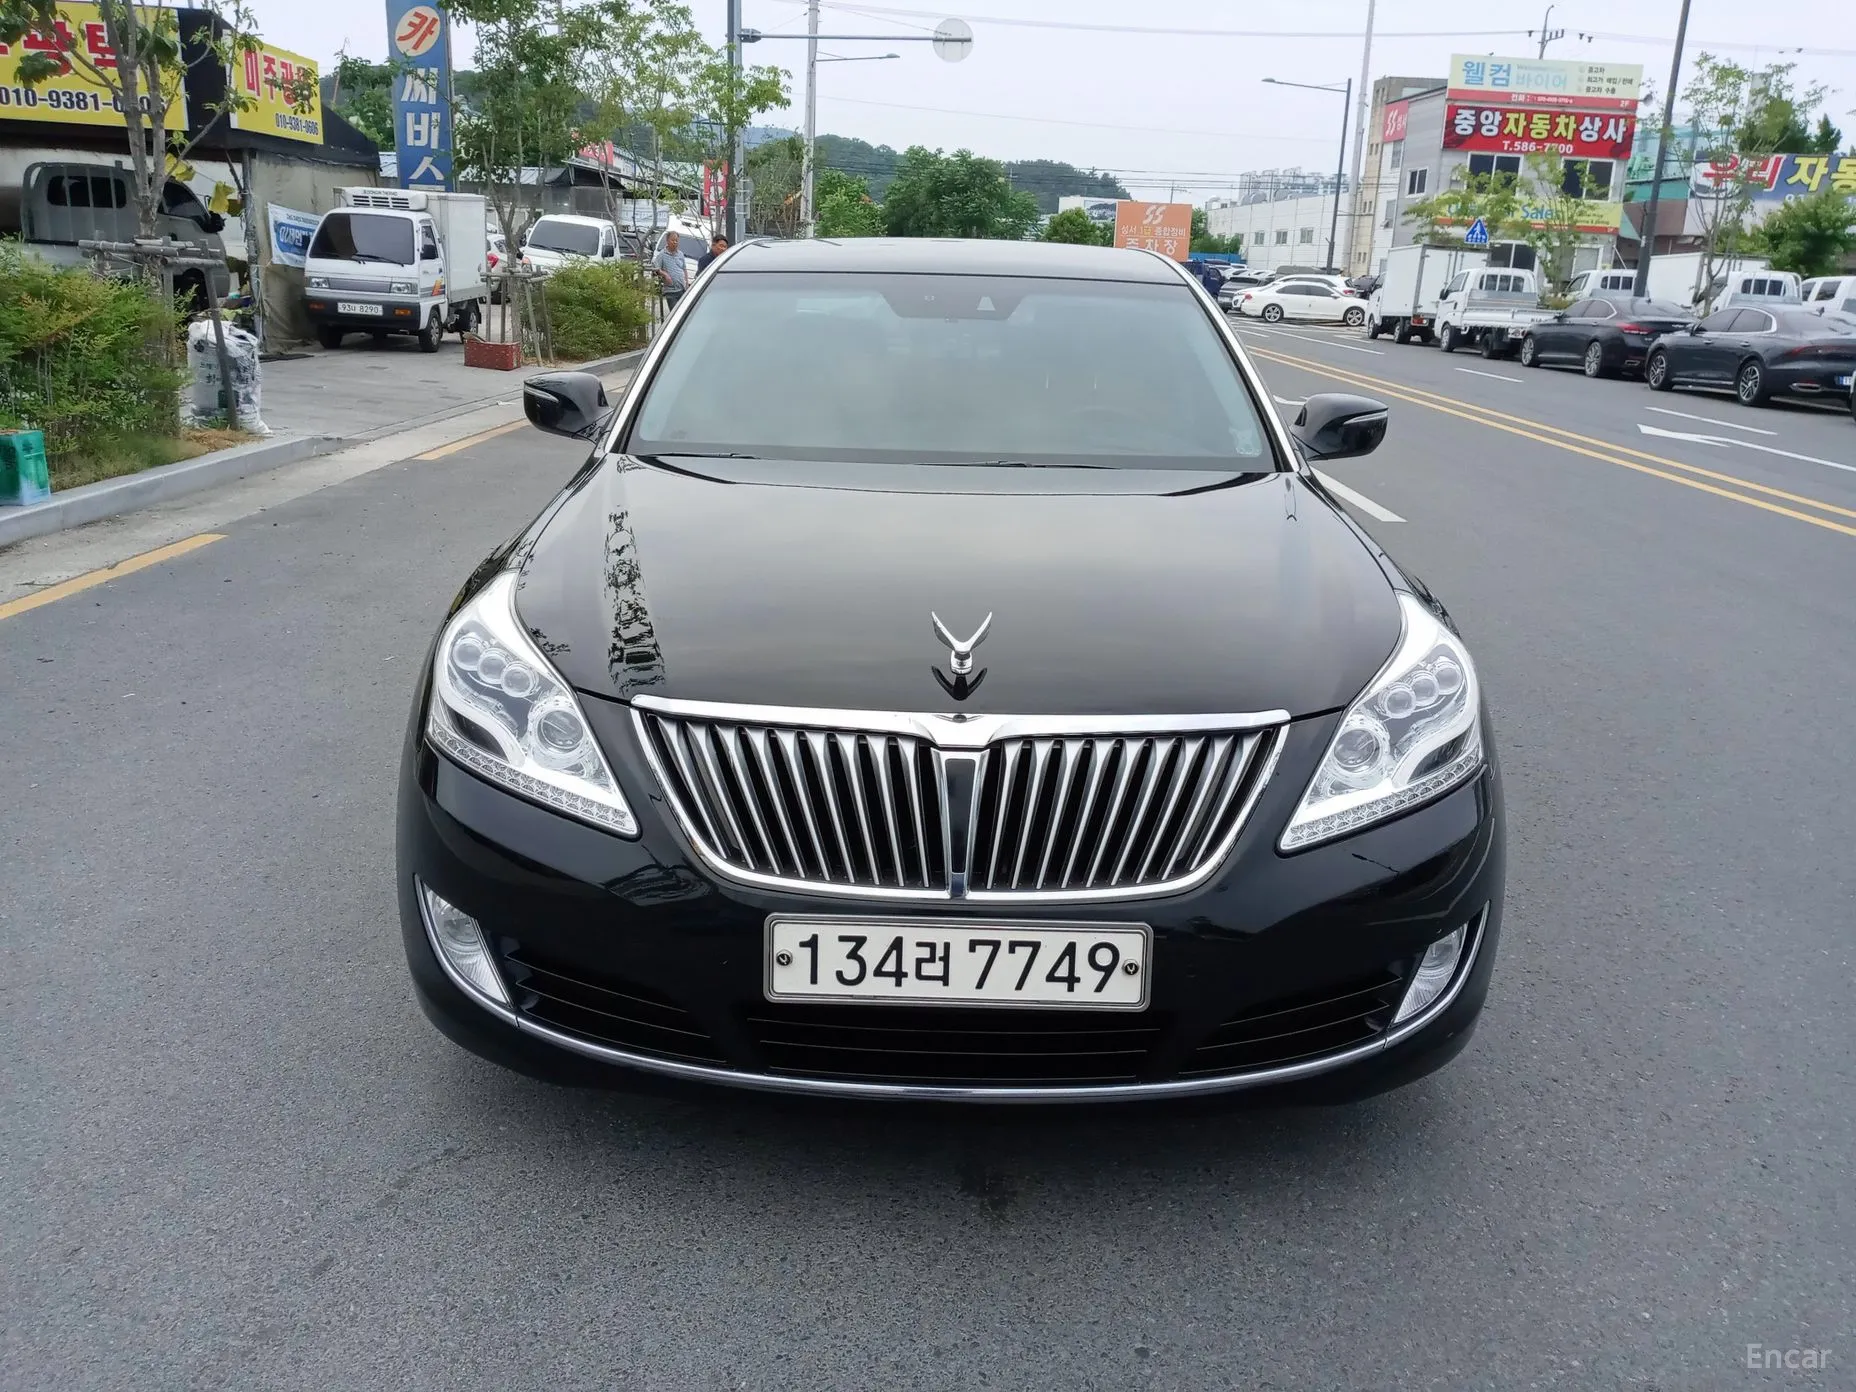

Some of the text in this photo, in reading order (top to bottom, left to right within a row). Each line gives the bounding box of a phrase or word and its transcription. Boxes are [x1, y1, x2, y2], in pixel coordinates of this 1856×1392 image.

[244, 48, 312, 106] 미주광
[1462, 61, 1511, 87] 웰컴
[0, 87, 166, 114] 010-9381-00
[1454, 108, 1628, 144] 중앙자동차상사
[968, 937, 1121, 994] 7749
